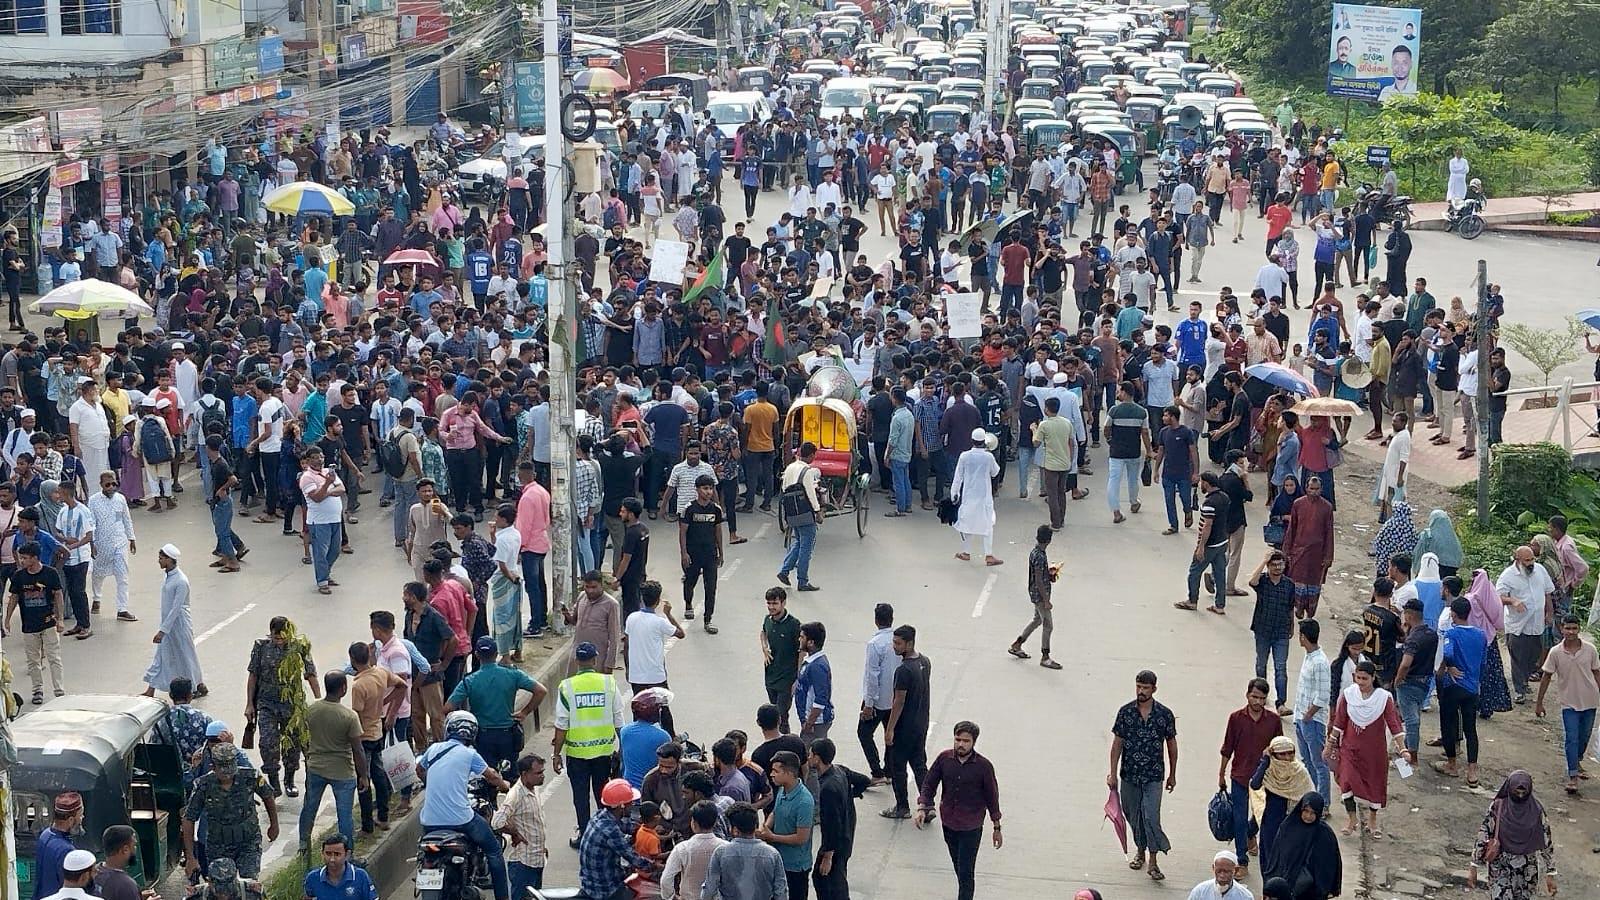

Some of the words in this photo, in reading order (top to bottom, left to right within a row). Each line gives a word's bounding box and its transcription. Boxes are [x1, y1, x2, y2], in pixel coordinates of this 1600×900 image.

[504, 251, 516, 265] 28
[987, 408, 1002, 426] 15
[1364, 626, 1380, 656] 21
[576, 694, 606, 708] POLICE
